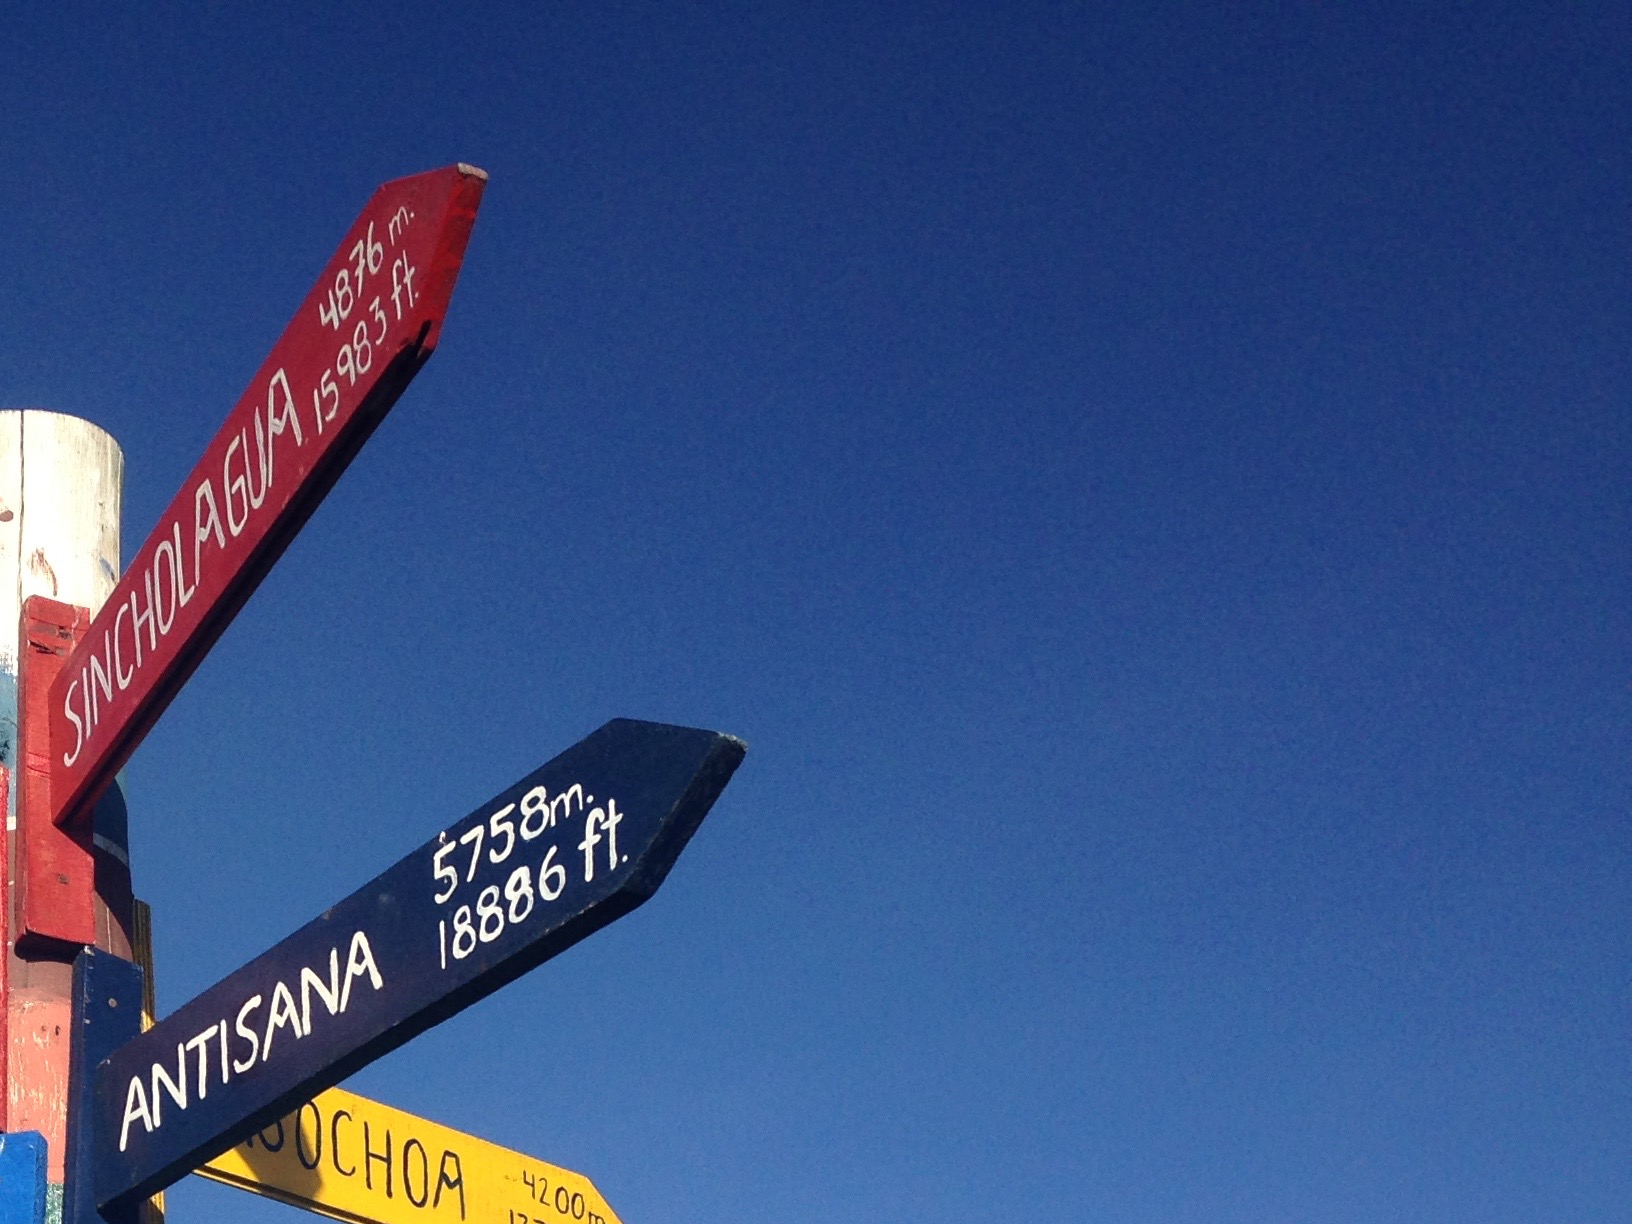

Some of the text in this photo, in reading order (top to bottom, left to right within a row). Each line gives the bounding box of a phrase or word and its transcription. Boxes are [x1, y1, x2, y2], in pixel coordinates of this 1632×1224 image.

[319, 221, 383, 330] 4876
[313, 297, 387, 435] 15983
[63, 367, 303, 768] SINCHOLAGUA
[440, 845, 567, 969] 18886
[119, 930, 384, 1152] ANTISANA
[245, 1101, 466, 1221] OCHOA
